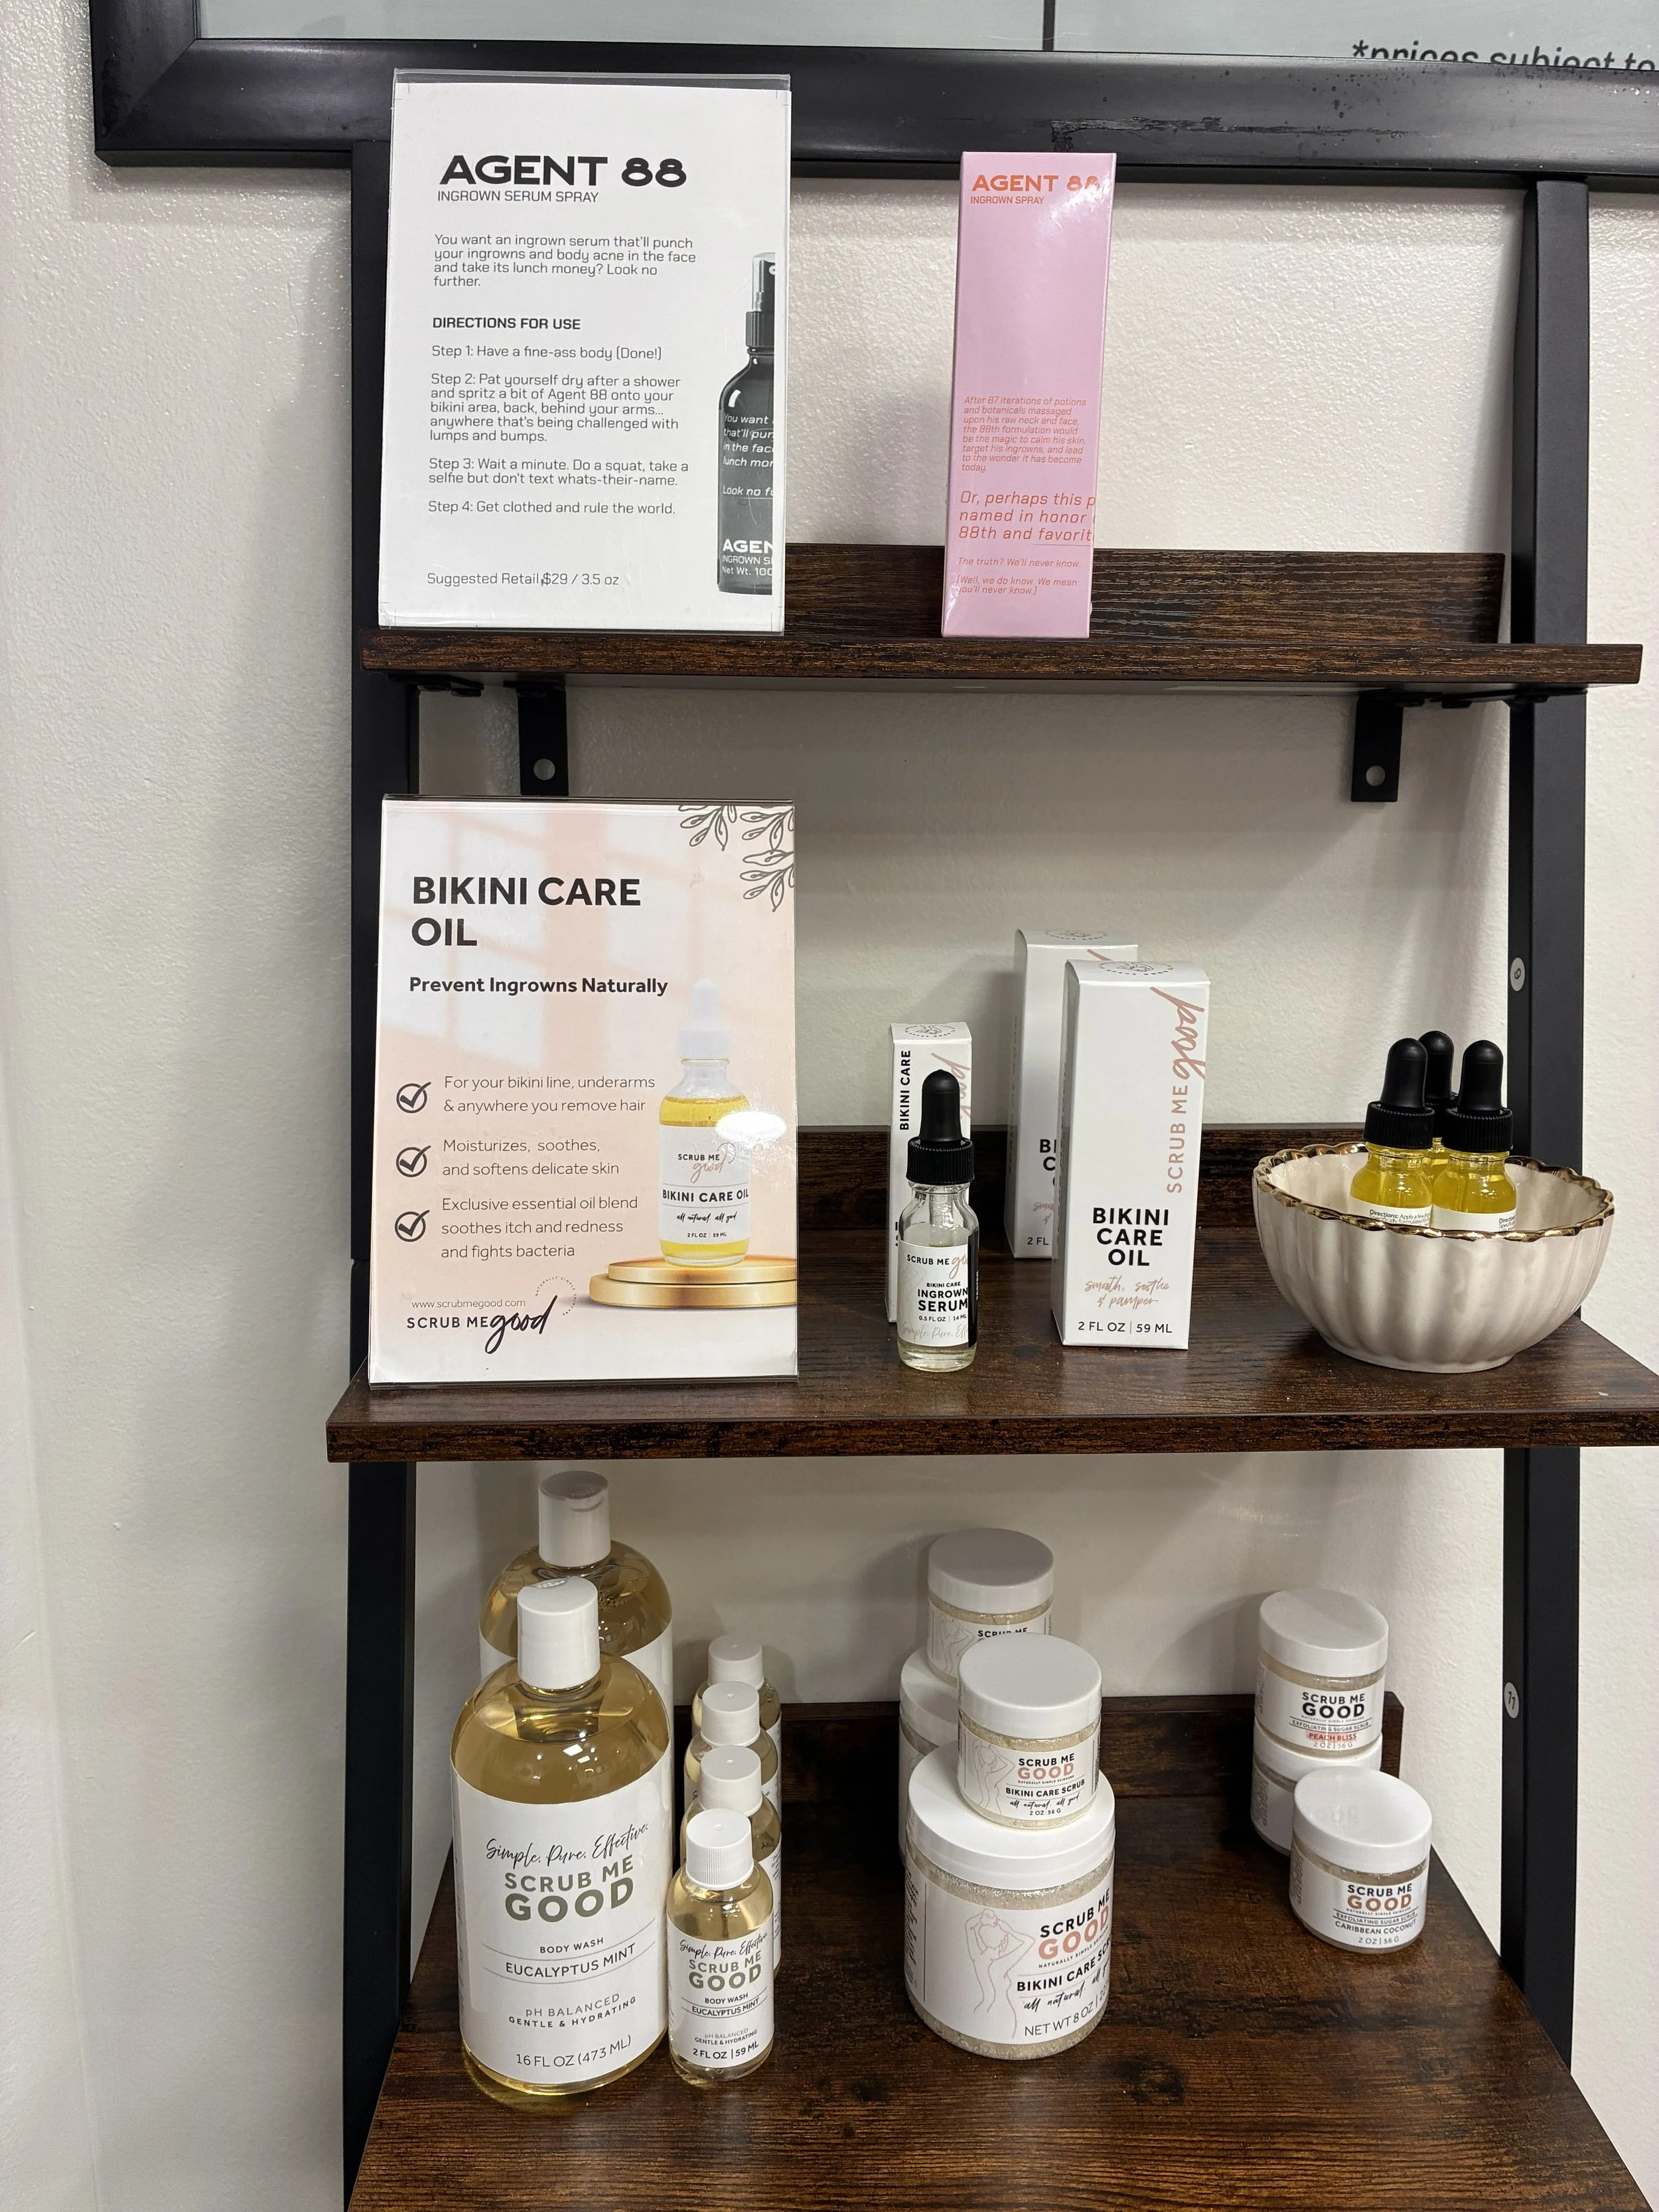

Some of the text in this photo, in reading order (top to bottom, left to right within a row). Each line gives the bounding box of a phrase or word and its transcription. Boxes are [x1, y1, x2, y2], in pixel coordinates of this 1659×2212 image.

[439, 155, 687, 188] AGENT 88
[972, 175, 1059, 191] AGENT
[437, 190, 599, 202] INGROWN SERUM SPRAY
[1015, 196, 1045, 204] SPRAY
[435, 234, 693, 250] You want an ingrown serum that'll punch
[435, 248, 695, 263] your ingrowns and body acne in the face
[433, 317, 581, 330] DIRECTIONS FOR USE
[432, 345, 462, 358] Step
[465, 345, 474, 356] 1:
[476, 346, 509, 356] Have
[512, 348, 520, 357] a
[524, 346, 576, 358] fine-ass
[580, 347, 612, 361] body
[741, 415, 769, 424] want
[979, 425, 1000, 433] 88th
[1003, 425, 1050, 434] formulation
[960, 490, 1082, 508] Or, perhaps this
[960, 509, 1087, 523] named in honor
[959, 526, 1033, 540] 88th and
[413, 877, 641, 906] BIKINI CARE
[411, 918, 478, 946] OIL
[409, 977, 668, 997] Prevent Ingrowns Naturally
[445, 1076, 656, 1092] For your bikini line, underarms
[900, 1051, 910, 1130] BIKINI CARE
[1149, 986, 1206, 1194] SCRUB ME good
[443, 1139, 601, 1153] Moisturizes, soothes,
[662, 1189, 749, 1202] BIKINI CARE OIL
[1093, 1207, 1169, 1226] BIKINI
[1097, 1228, 1163, 1246] CARE
[907, 1254, 934, 1265] SCRUB
[1108, 1248, 1149, 1266] OIL
[918, 1288, 968, 1299] INGROWN
[411, 1299, 526, 1309] www.scrubmegood.com
[918, 1298, 968, 1312] SERUM
[406, 1294, 558, 1355] SCRUB ME good
[1078, 1321, 1125, 1332] 2 FL OZ
[1136, 1323, 1172, 1333] 59 ML
[1302, 1692, 1365, 1704] SCRUB ME
[1302, 1702, 1364, 1719] GOOD
[1309, 1732, 1335, 1741] PEACH
[1019, 1753, 1074, 1767] SCRUB ME
[1017, 1763, 1074, 1780] GOOD
[1005, 1787, 1033, 1797] BIKINI
[1062, 1779, 1085, 1794] SCRUB
[486, 1838, 541, 1870] Simple.
[504, 1854, 634, 1893] SCRUB ME
[1347, 1883, 1412, 1897] SCRUB ME
[505, 1877, 634, 1923] GOOD
[1347, 1893, 1411, 1912] GOOD
[1040, 1887, 1110, 1938] SCRUB ME
[1038, 1905, 1110, 1960] GOOD
[1335, 1919, 1416, 1935] CARIBBEAN COCONUT
[540, 1937, 604, 1954] BODY WASH
[506, 1943, 636, 1978] EUCALYPTUS MINT
[688, 1950, 762, 1974] SCRUB ME
[688, 1963, 762, 1992] GOOD
[1017, 1957, 1096, 1992] BIKINI CARE
[526, 1993, 620, 2018] pH BALANCED
[692, 1997, 760, 2016] EUCALYPTUS MINT
[727, 1992, 749, 2004] WASH
[1025, 2000, 1094, 2037] NET WT 8 OZ
[516, 2035, 631, 2067] 16 FL OZ (473 ML)
[693, 2047, 699, 2057] 2
[700, 2051, 711, 2059] FL
[735, 2040, 759, 2057] 59 ML
